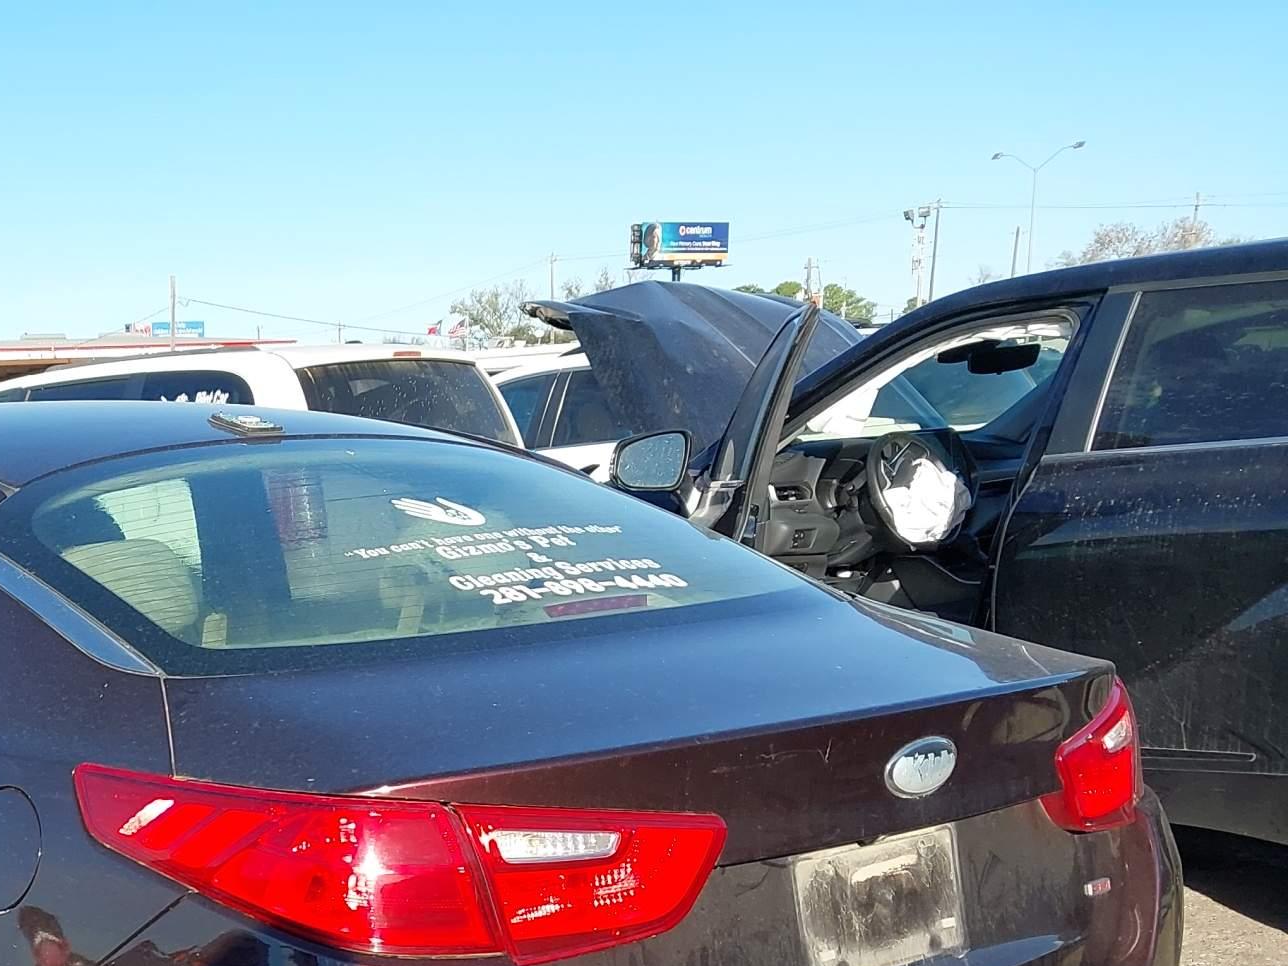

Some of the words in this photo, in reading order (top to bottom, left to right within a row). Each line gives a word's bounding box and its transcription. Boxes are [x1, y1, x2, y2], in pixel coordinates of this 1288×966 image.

[431, 535, 474, 546] have
[473, 531, 503, 541] one
[502, 525, 558, 538] without
[557, 525, 586, 535] the
[436, 538, 533, 560] Gizmo's
[528, 535, 576, 548] Pet
[526, 552, 553, 563] &
[449, 566, 564, 590] Cleaning
[555, 558, 662, 576] Services
